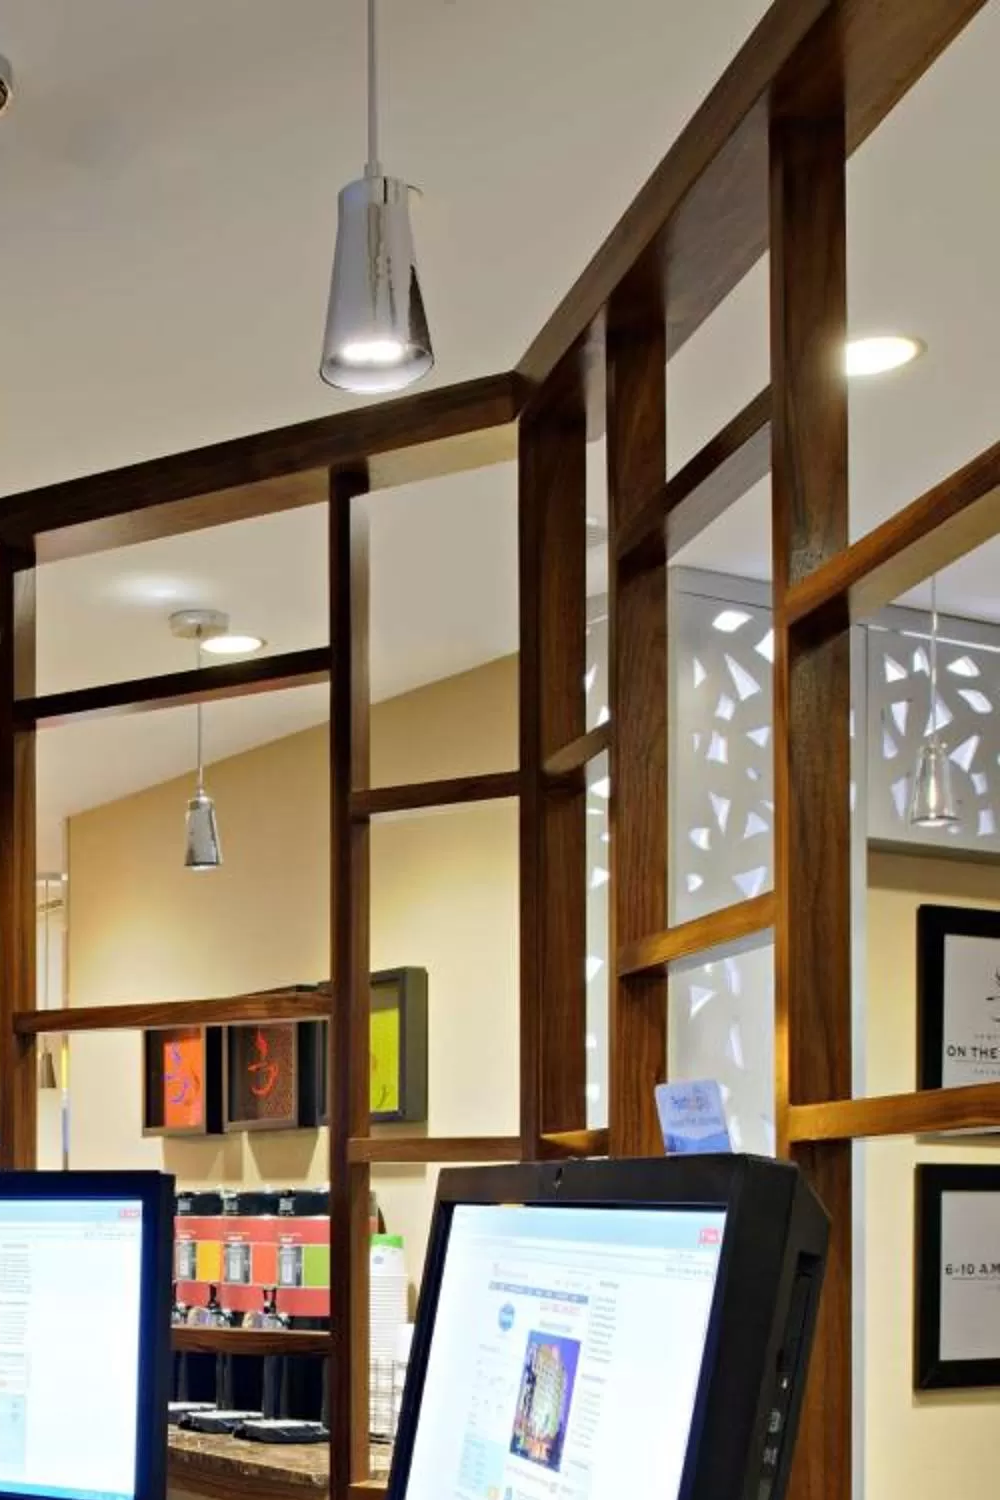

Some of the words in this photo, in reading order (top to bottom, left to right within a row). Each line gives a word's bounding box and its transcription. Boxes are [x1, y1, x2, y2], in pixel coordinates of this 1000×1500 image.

[946, 1044, 967, 1057] ON
[971, 1046, 999, 1060] THE
[945, 1263, 975, 1277] 6-10
